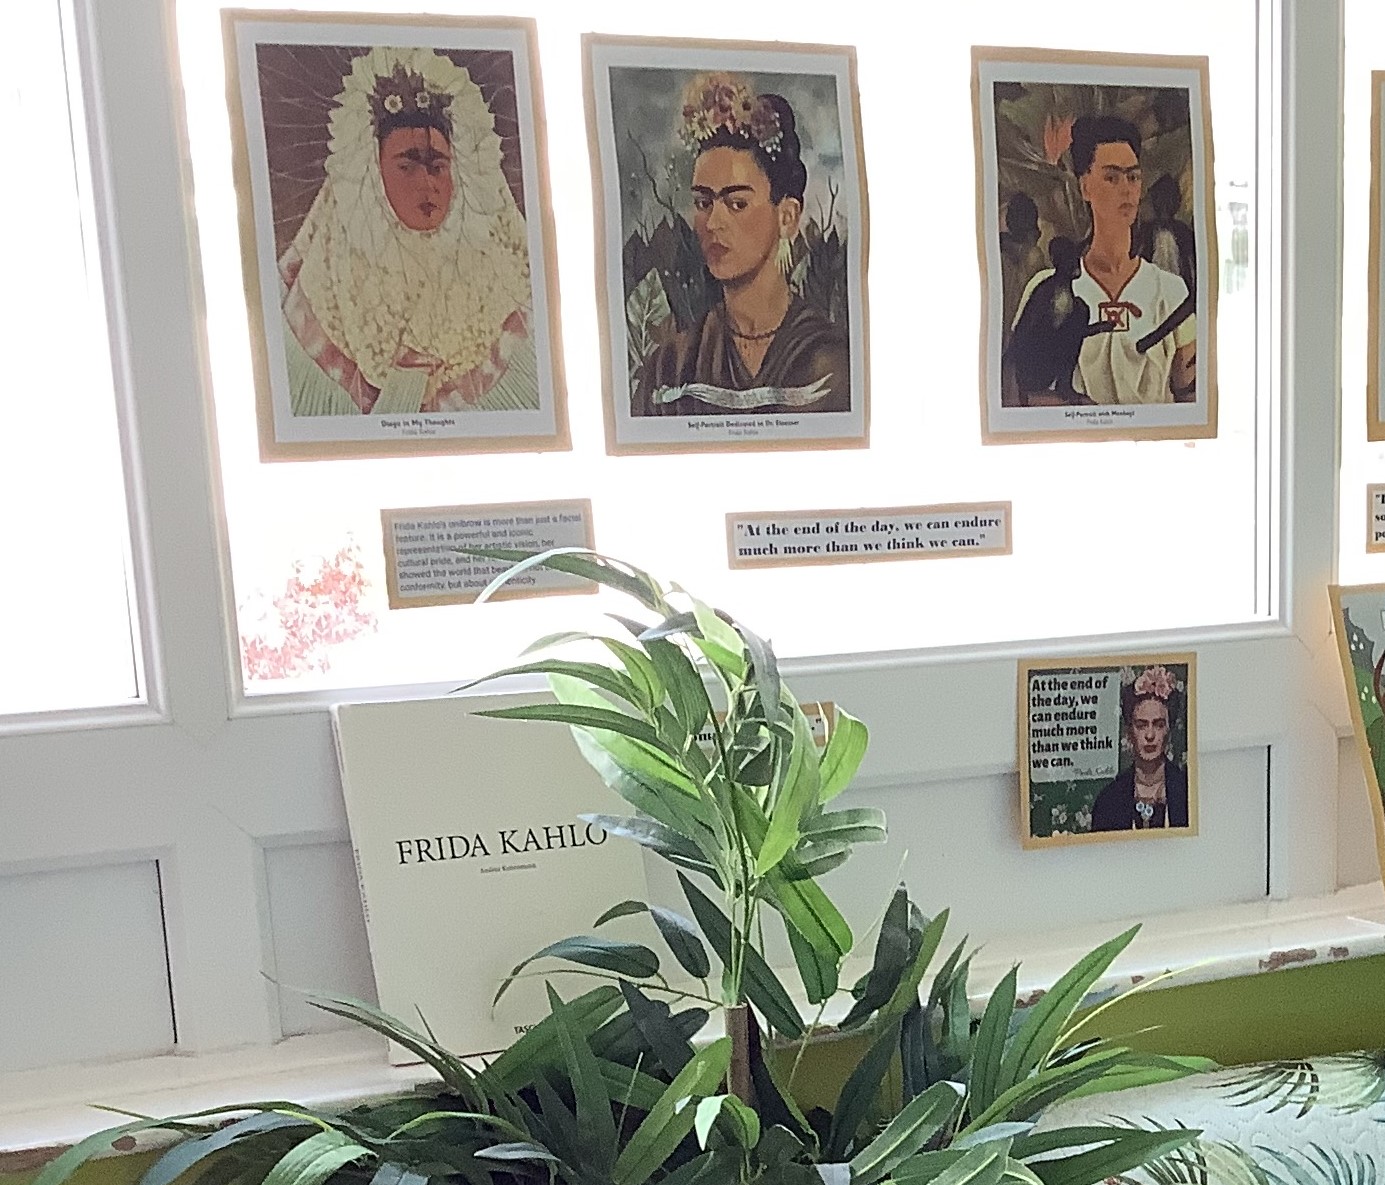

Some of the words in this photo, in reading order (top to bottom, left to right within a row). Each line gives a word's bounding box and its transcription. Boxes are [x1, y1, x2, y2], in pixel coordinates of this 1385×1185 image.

[737, 524, 761, 537] "At
[766, 523, 789, 536] the
[793, 522, 820, 535] end
[825, 521, 840, 534] of
[844, 521, 867, 533] the
[904, 521, 922, 531] we
[926, 520, 950, 530] can
[954, 516, 1002, 528] endure
[738, 543, 778, 556] much
[783, 544, 821, 554] more
[826, 541, 859, 553] than
[863, 542, 882, 551] we
[887, 537, 924, 550] think
[929, 539, 947, 548] we
[951, 533, 985, 547] can."
[1032, 679, 1046, 691] At
[1047, 678, 1068, 691] the
[1070, 676, 1092, 690] end
[1094, 676, 1109, 689] of
[1032, 694, 1052, 707] the
[1053, 693, 1079, 708] day,
[1080, 695, 1098, 705] we
[1031, 712, 1052, 723] can
[1054, 707, 1097, 720] endure
[1032, 724, 1063, 738] much
[1065, 725, 1097, 735] more
[1032, 740, 1059, 754] than
[1061, 741, 1078, 751] we
[1080, 736, 1112, 750] think
[1032, 758, 1049, 768] we
[1050, 757, 1074, 767] can.
[396, 833, 491, 865] FRIDA
[498, 823, 607, 855] KAHLO
